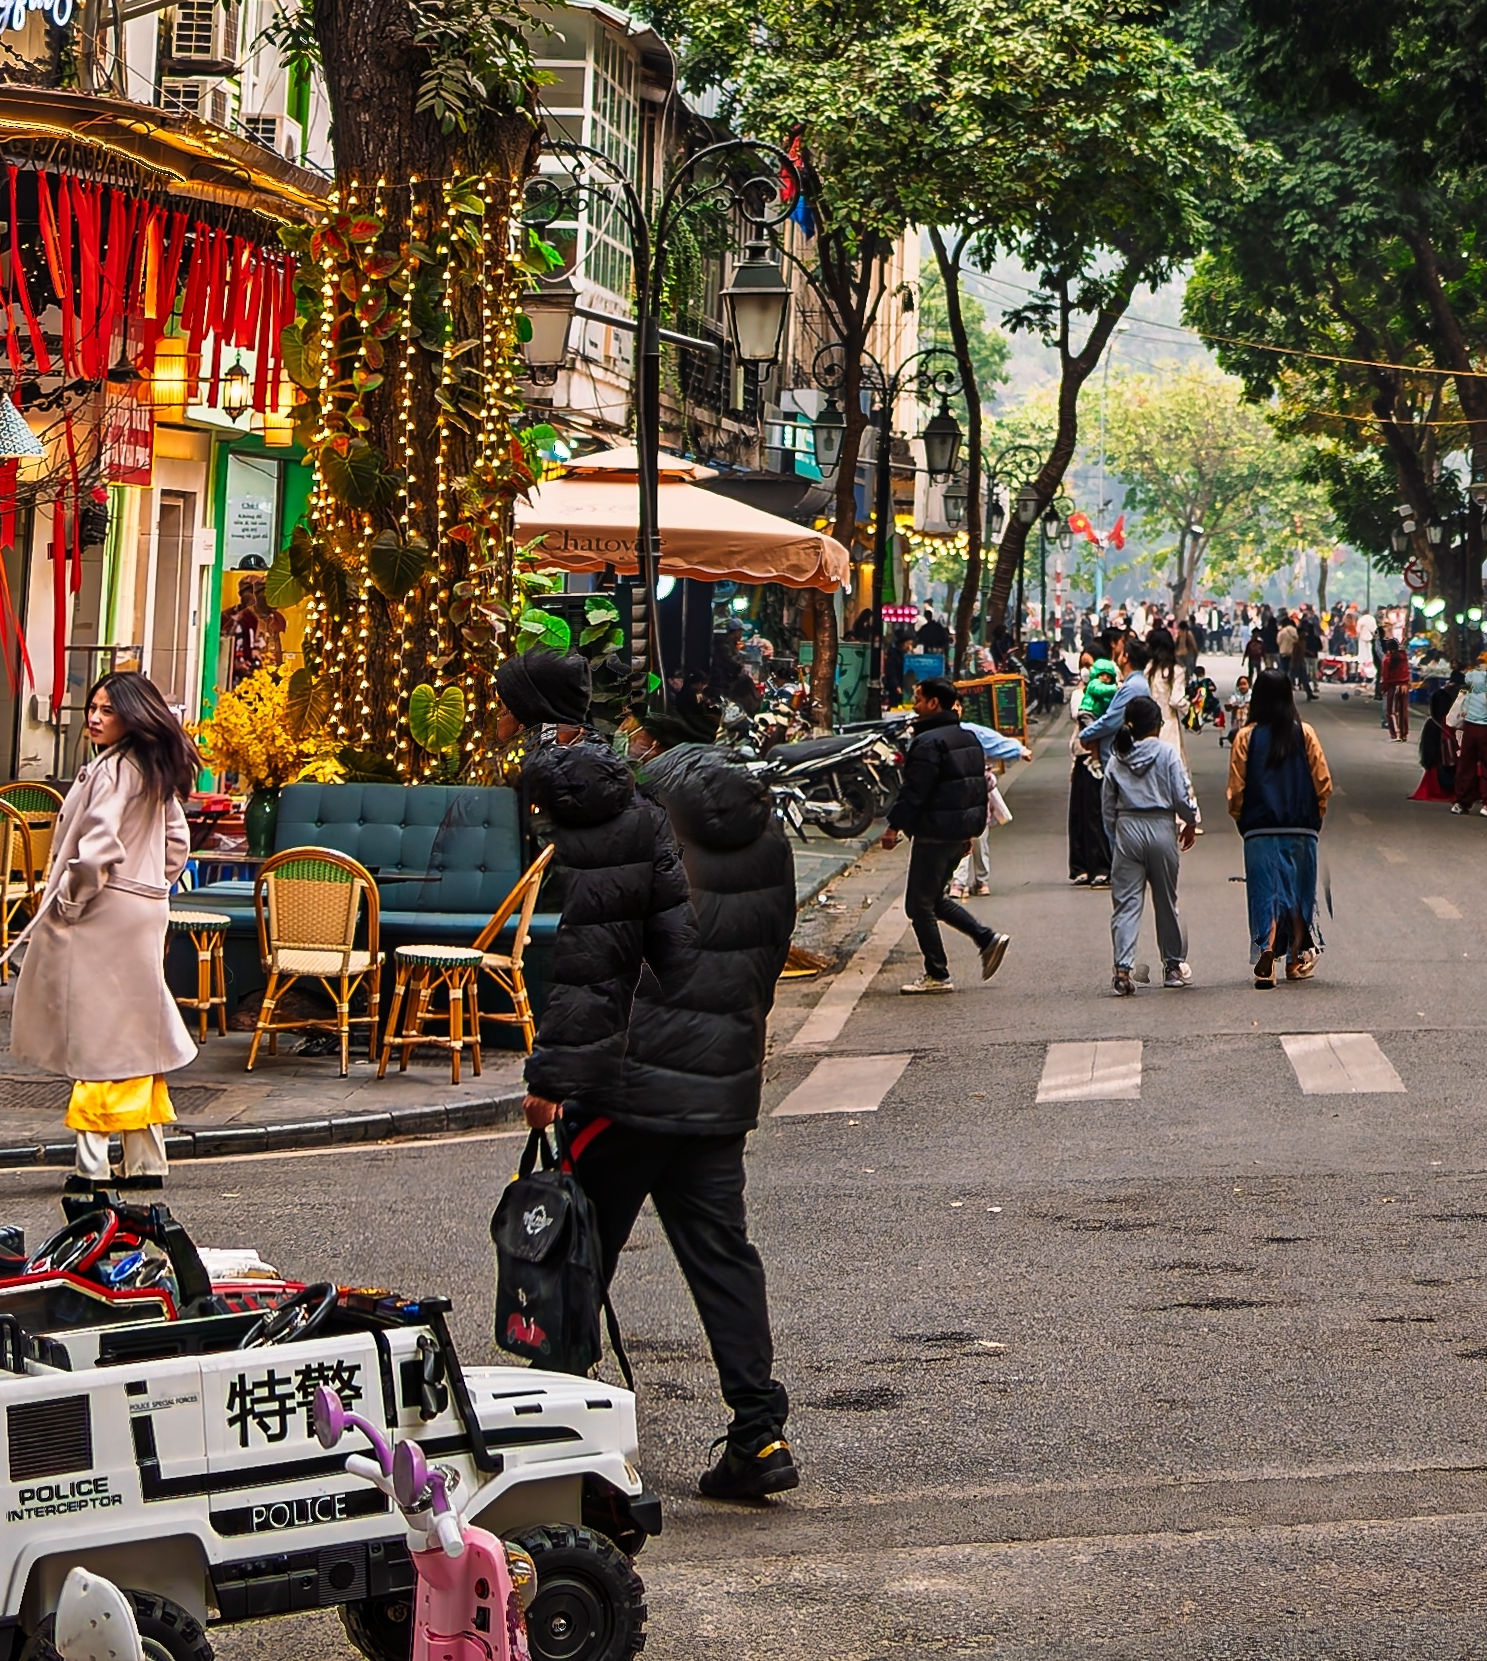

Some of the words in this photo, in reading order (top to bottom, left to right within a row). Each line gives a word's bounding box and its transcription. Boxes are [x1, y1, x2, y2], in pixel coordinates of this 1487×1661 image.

[539, 528, 667, 561] Chatoy
[18, 1476, 109, 1506] POLICE
[6, 1493, 123, 1523] INTERCEPTOR
[252, 1493, 347, 1532] POLICE
